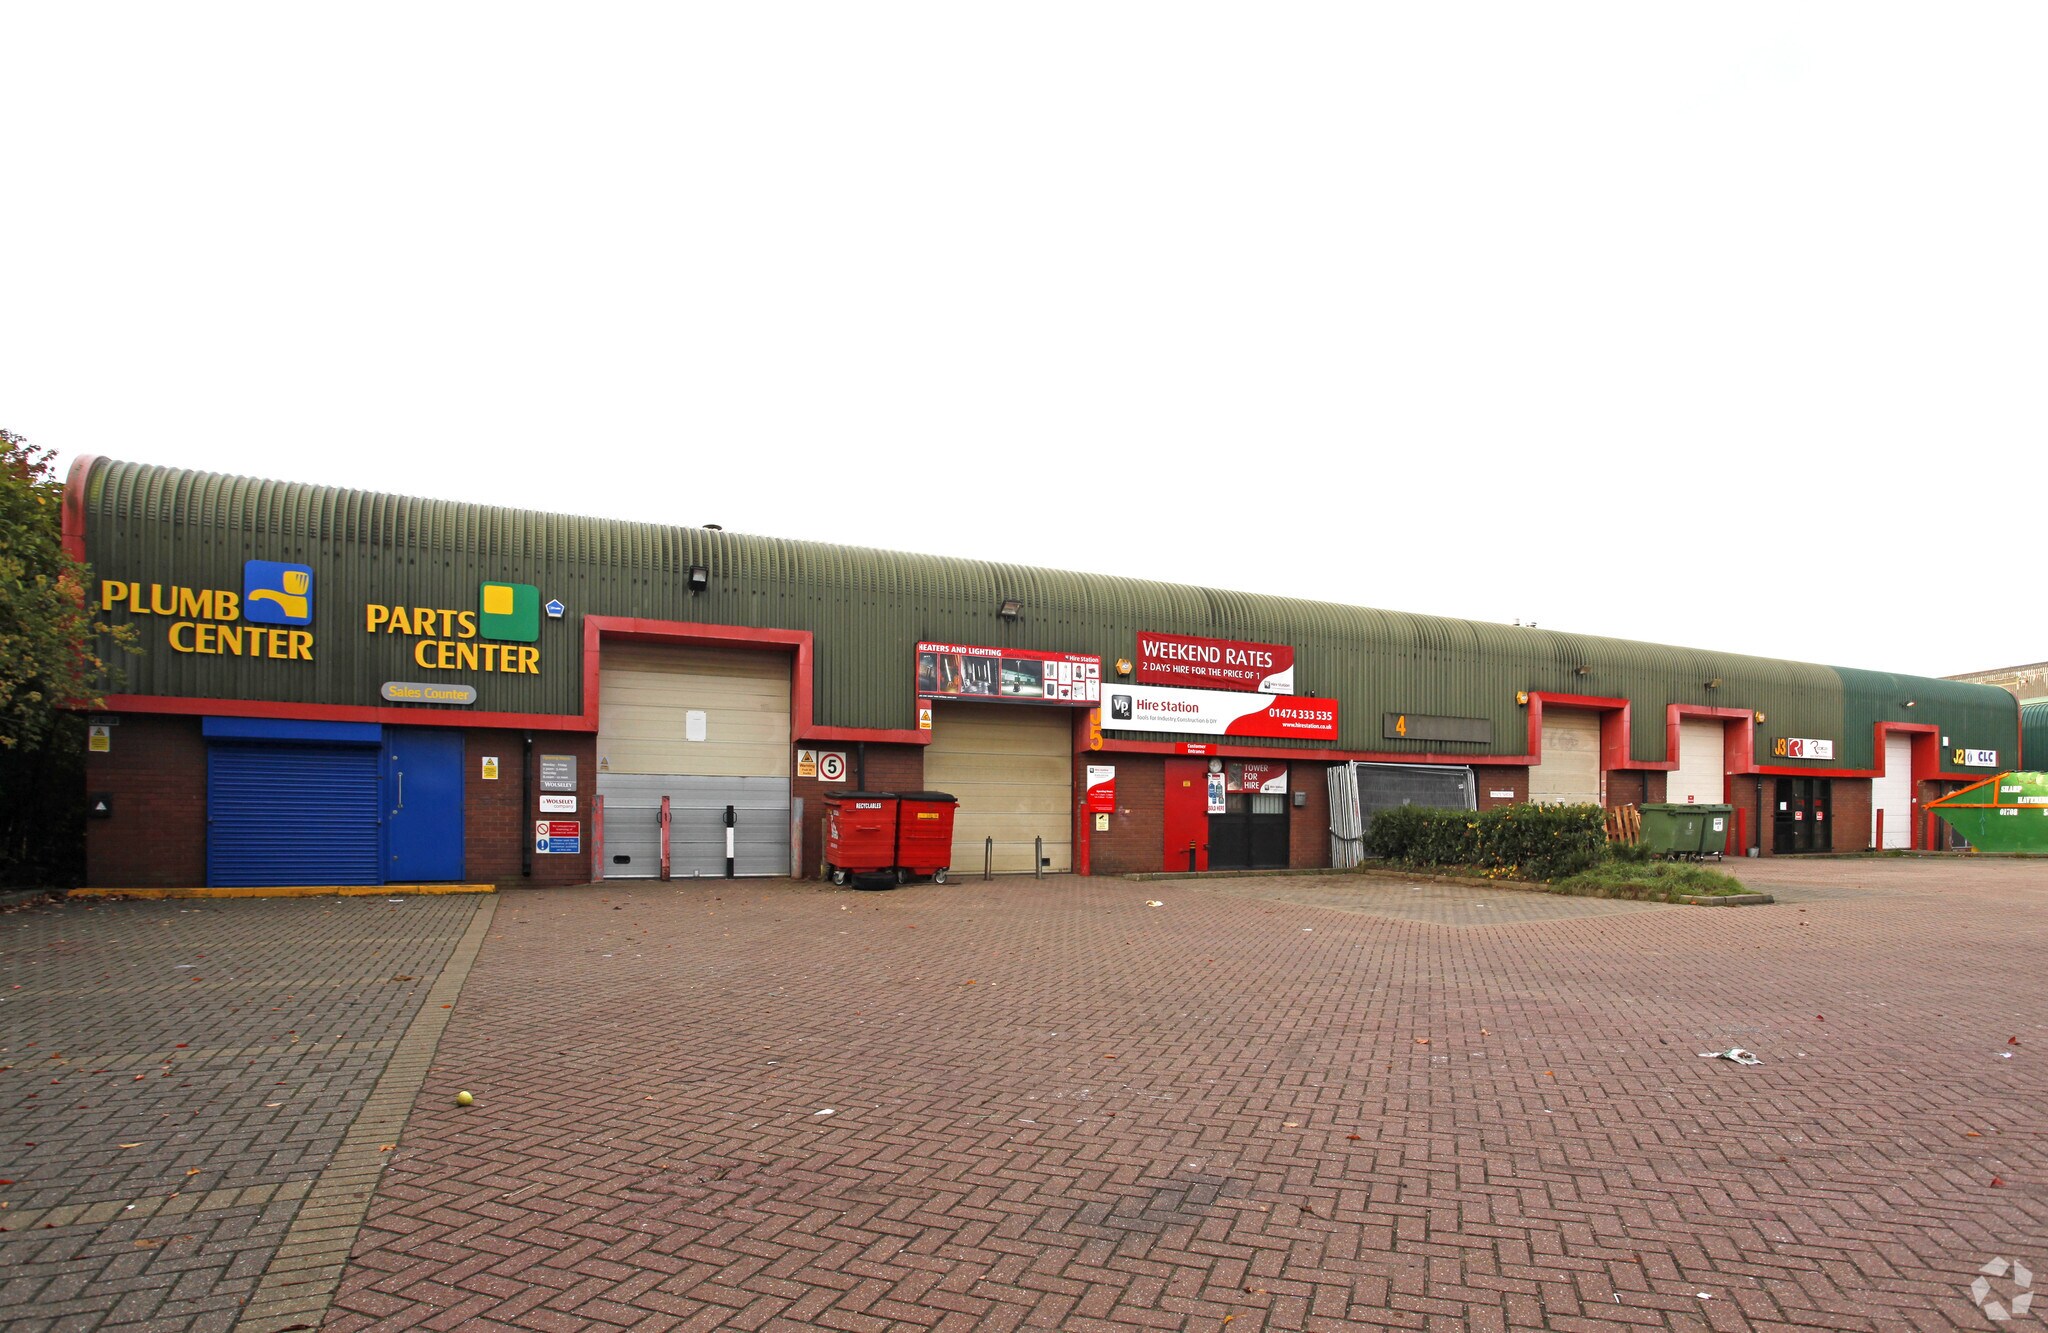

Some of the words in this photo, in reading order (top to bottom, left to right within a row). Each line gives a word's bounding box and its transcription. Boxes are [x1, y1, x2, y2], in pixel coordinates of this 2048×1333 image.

[102, 580, 240, 621] PLUMB
[366, 604, 477, 638] PARTS
[168, 622, 314, 661] CENTER
[414, 640, 540, 674] CENTER
[918, 644, 949, 653] HEATERS
[951, 646, 967, 654] AND
[968, 647, 1001, 656] LIGHTING
[1142, 640, 1221, 663] WEEKEND
[1226, 648, 1273, 668] RATES
[1142, 662, 1148, 670] 2
[1150, 663, 1171, 673] DAYS
[1172, 665, 1189, 674] HIRE
[1191, 666, 1206, 675] FOR
[1208, 668, 1222, 676] THE
[1223, 669, 1243, 678] PRICE
[1244, 671, 1254, 679] OF
[1256, 672, 1260, 680] 1
[388, 685, 421, 699] Sales
[424, 687, 470, 700] Counter
[1113, 698, 1129, 713] Vp
[1136, 699, 1159, 711] Hire
[1161, 701, 1199, 713] Station
[1268, 708, 1297, 719] 01474
[1298, 710, 1314, 719] 333
[1316, 711, 1332, 720] 535
[1282, 722, 1332, 730] www.hirestation.co.uk
[1395, 715, 1406, 737] 4
[1774, 738, 1786, 755] J3
[1953, 749, 1964, 764] J2
[1978, 751, 1993, 762] CLC
[827, 759, 837, 774] 5
[1244, 764, 1269, 772] TOWER
[1244, 773, 1258, 781] FOR
[1244, 781, 1260, 789] HIRE
